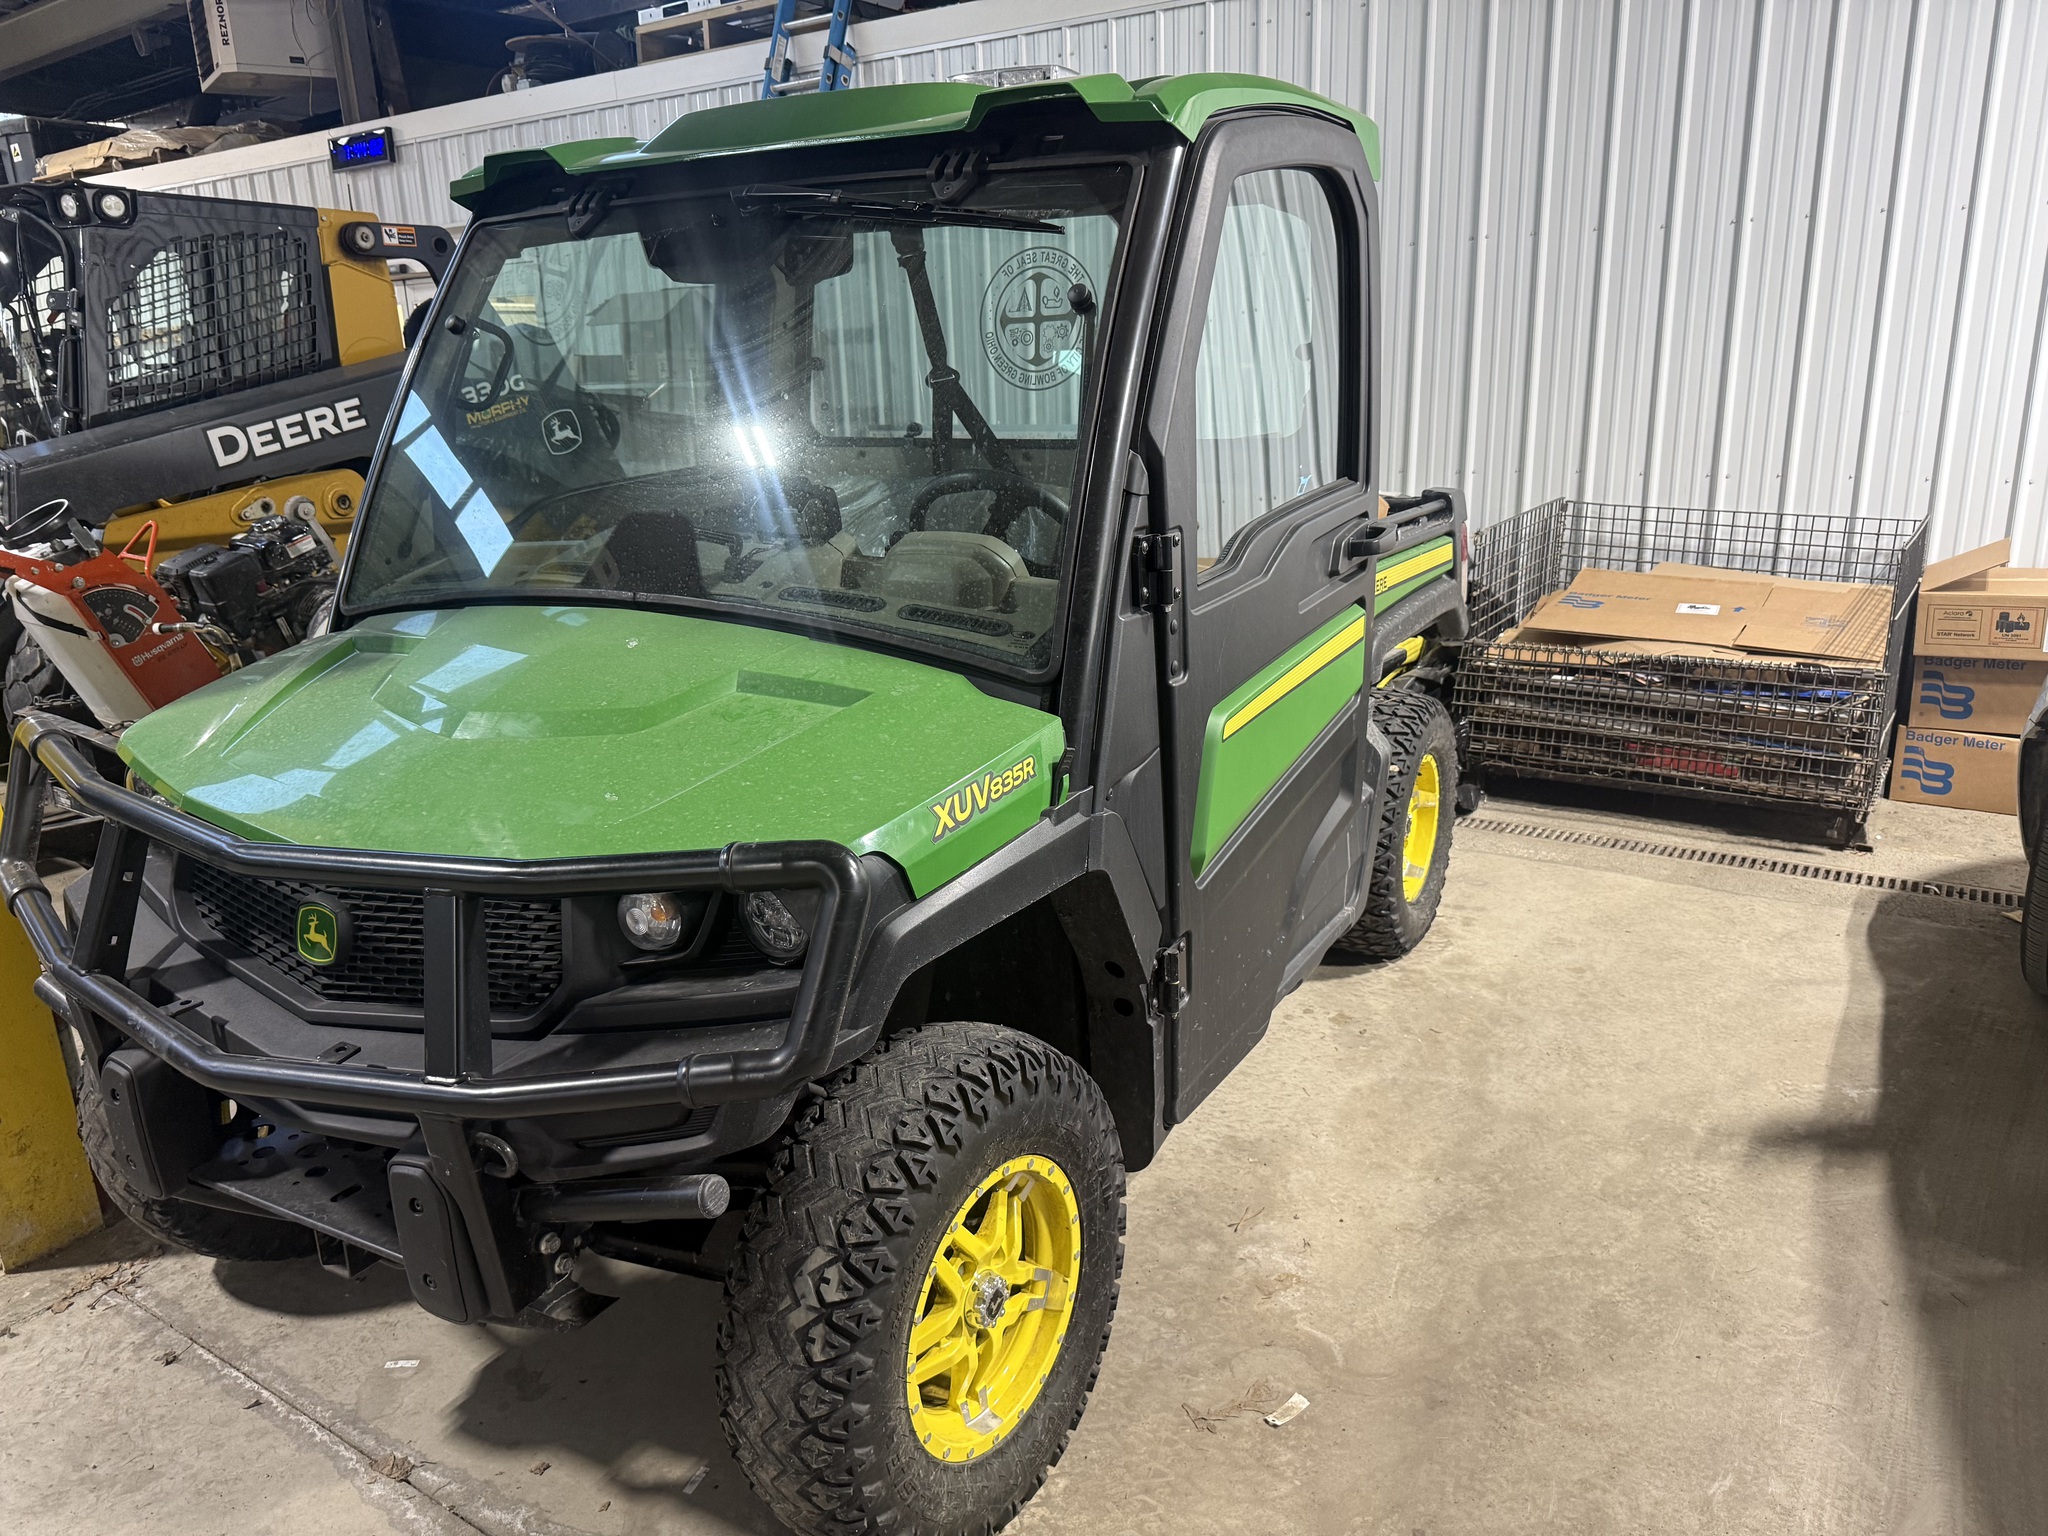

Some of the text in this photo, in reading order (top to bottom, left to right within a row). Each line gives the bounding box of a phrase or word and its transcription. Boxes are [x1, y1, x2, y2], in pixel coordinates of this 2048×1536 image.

[206, 397, 367, 468] DEERE
[1376, 575, 1388, 593] ERE
[142, 632, 185, 661] Husqvarna
[1923, 655, 2027, 671] Badger Meter
[1906, 730, 2006, 750] Badger Meter
[931, 755, 1037, 840] XUV835R
